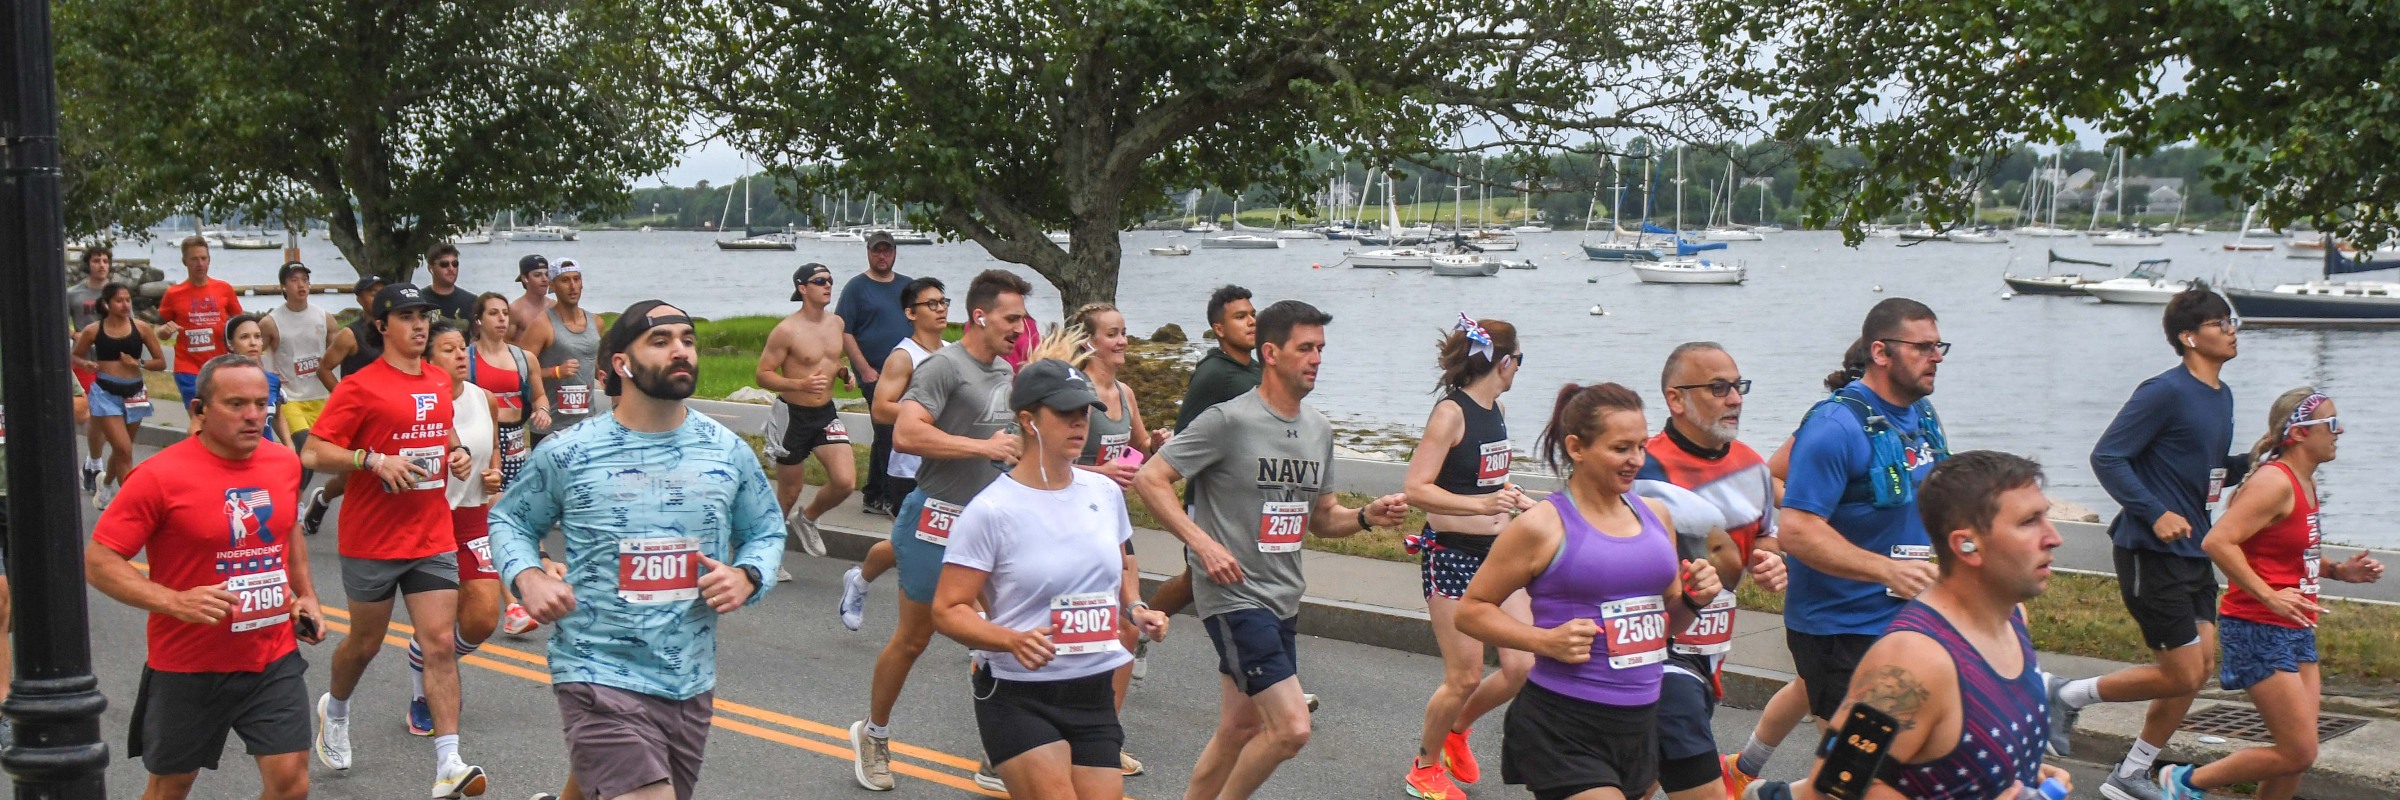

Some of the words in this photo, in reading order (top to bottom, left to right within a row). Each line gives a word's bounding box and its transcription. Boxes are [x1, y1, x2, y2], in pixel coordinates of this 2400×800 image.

[410, 393, 438, 421] F
[563, 393, 586, 405] 2031
[392, 429, 449, 440] LACROSS
[411, 422, 444, 432] CLUB
[1257, 456, 1320, 486] NAVY
[1485, 452, 1509, 472] 2807
[928, 511, 960, 531] 257
[1268, 515, 1303, 535] 2578
[216, 544, 283, 559] INDEPENDENC
[630, 553, 688, 581] 2601
[240, 586, 285, 613] 2196
[1061, 608, 1111, 634] 2902
[1614, 613, 1666, 645] 2580
[1685, 611, 1729, 636] 2579
[1848, 734, 1878, 753] 0.20
